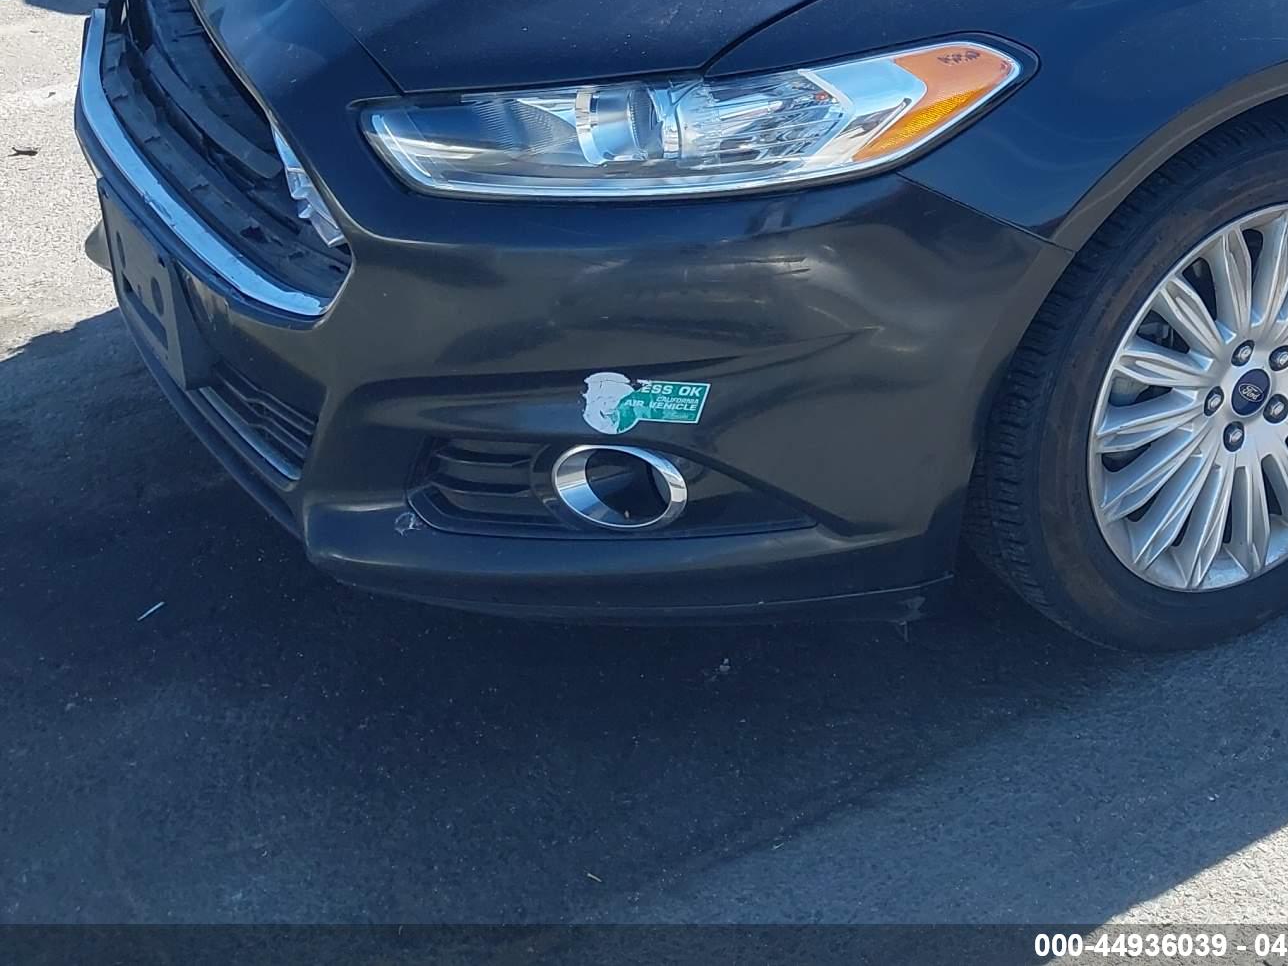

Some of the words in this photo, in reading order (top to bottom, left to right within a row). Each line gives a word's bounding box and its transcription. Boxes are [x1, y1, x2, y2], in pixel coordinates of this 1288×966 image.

[678, 385, 703, 397] OK
[623, 399, 646, 408] AIR
[648, 400, 698, 411] VEHICLE
[656, 395, 700, 404] CALIFORNIA
